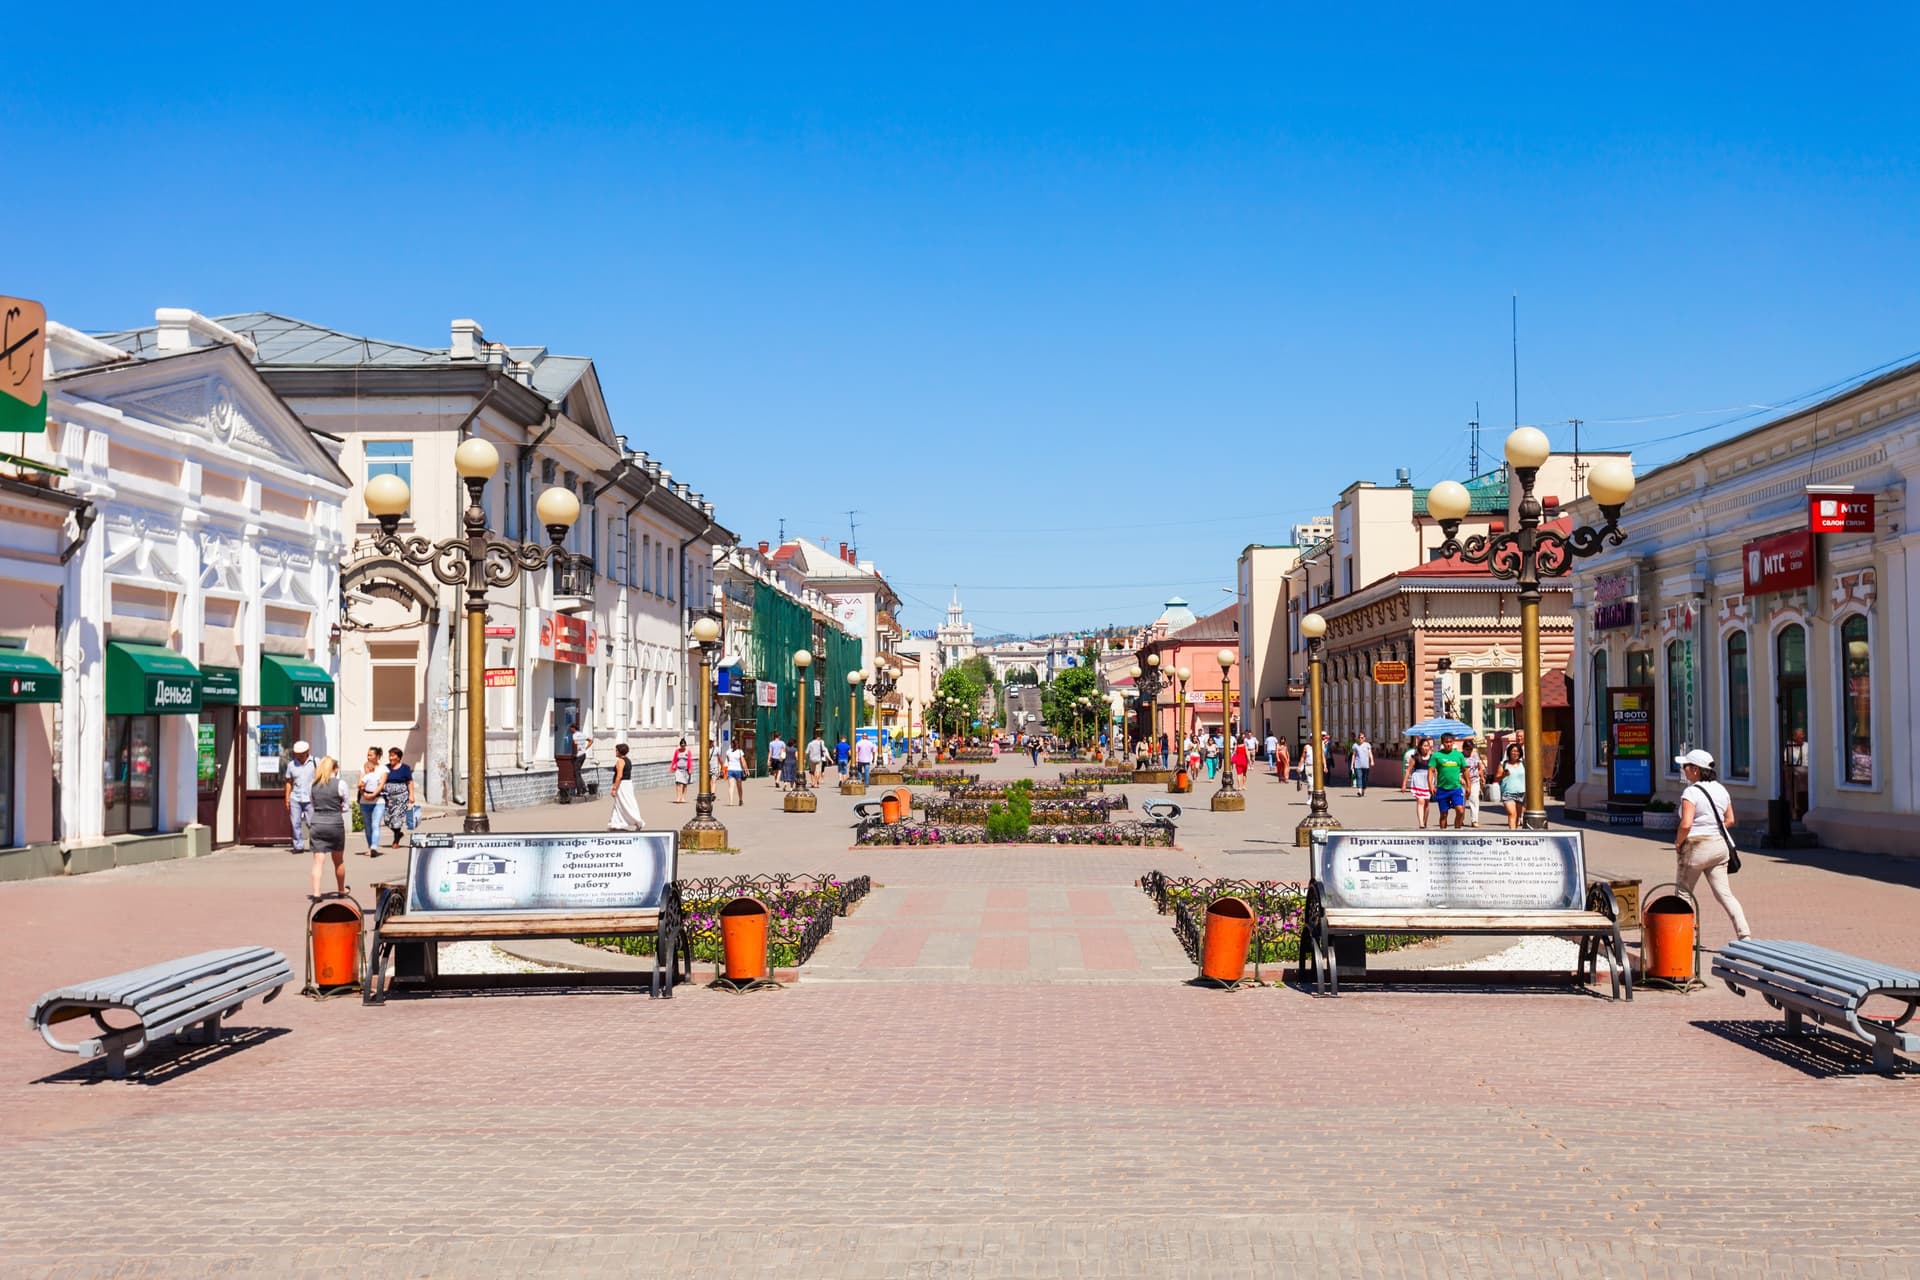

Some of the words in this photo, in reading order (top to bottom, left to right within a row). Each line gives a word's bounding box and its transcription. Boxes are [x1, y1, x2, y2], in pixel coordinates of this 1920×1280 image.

[1841, 504, 1868, 513] МТС
[1764, 553, 1786, 576] МТС
[21, 680, 36, 692] МТС
[155, 680, 193, 706] Деньга
[301, 686, 327, 702] ЧАСЫ
[1190, 692, 1205, 701] 585
[1624, 711, 1647, 719] ФОТО
[454, 840, 521, 850] риглашаем
[525, 839, 547, 847] Вас
[557, 838, 587, 848] кафе
[1350, 837, 1425, 846] Приглашаем
[1428, 838, 1448, 846] Вас
[1462, 838, 1493, 847] кафе
[565, 851, 622, 860] Требуются
[562, 862, 624, 870] официанты
[568, 871, 632, 880] постоянную
[574, 881, 610, 889] работу
